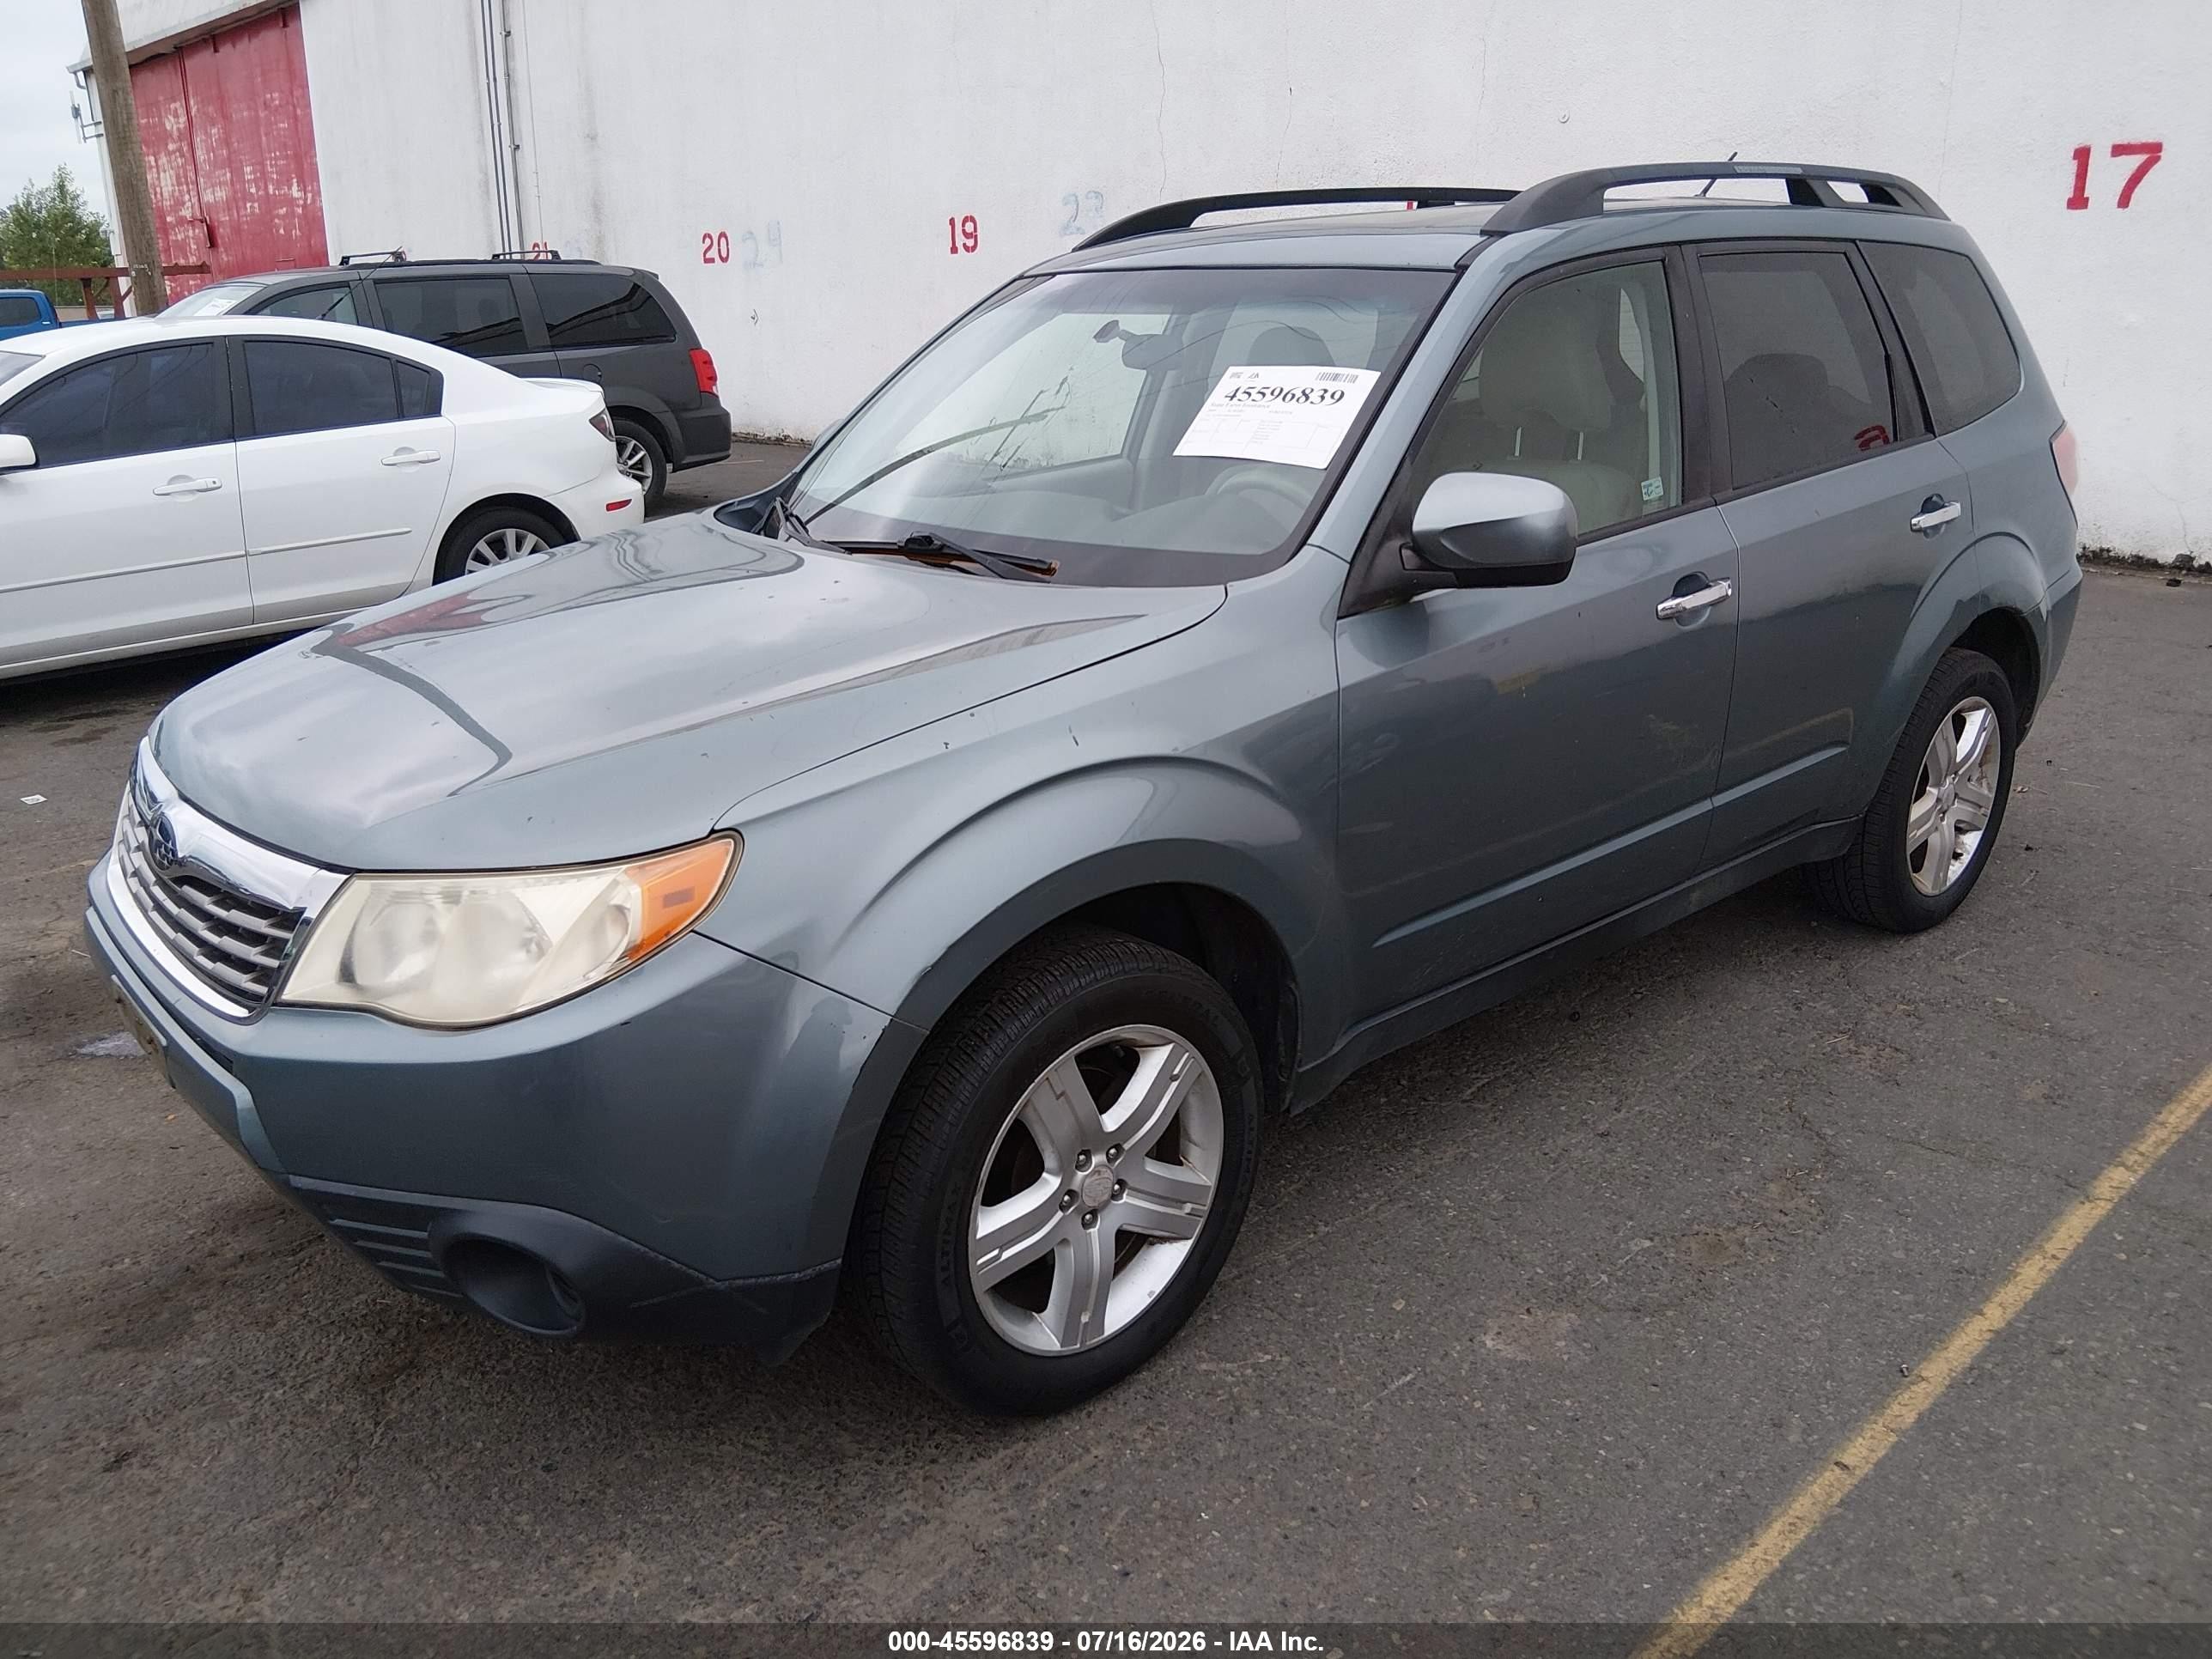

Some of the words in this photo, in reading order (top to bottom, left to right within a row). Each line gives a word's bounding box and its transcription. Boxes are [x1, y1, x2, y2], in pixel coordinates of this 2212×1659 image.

[2066, 141, 2163, 210] 17
[702, 231, 730, 264] 20
[948, 214, 979, 255] 19
[1224, 386, 1345, 405] 45596839
